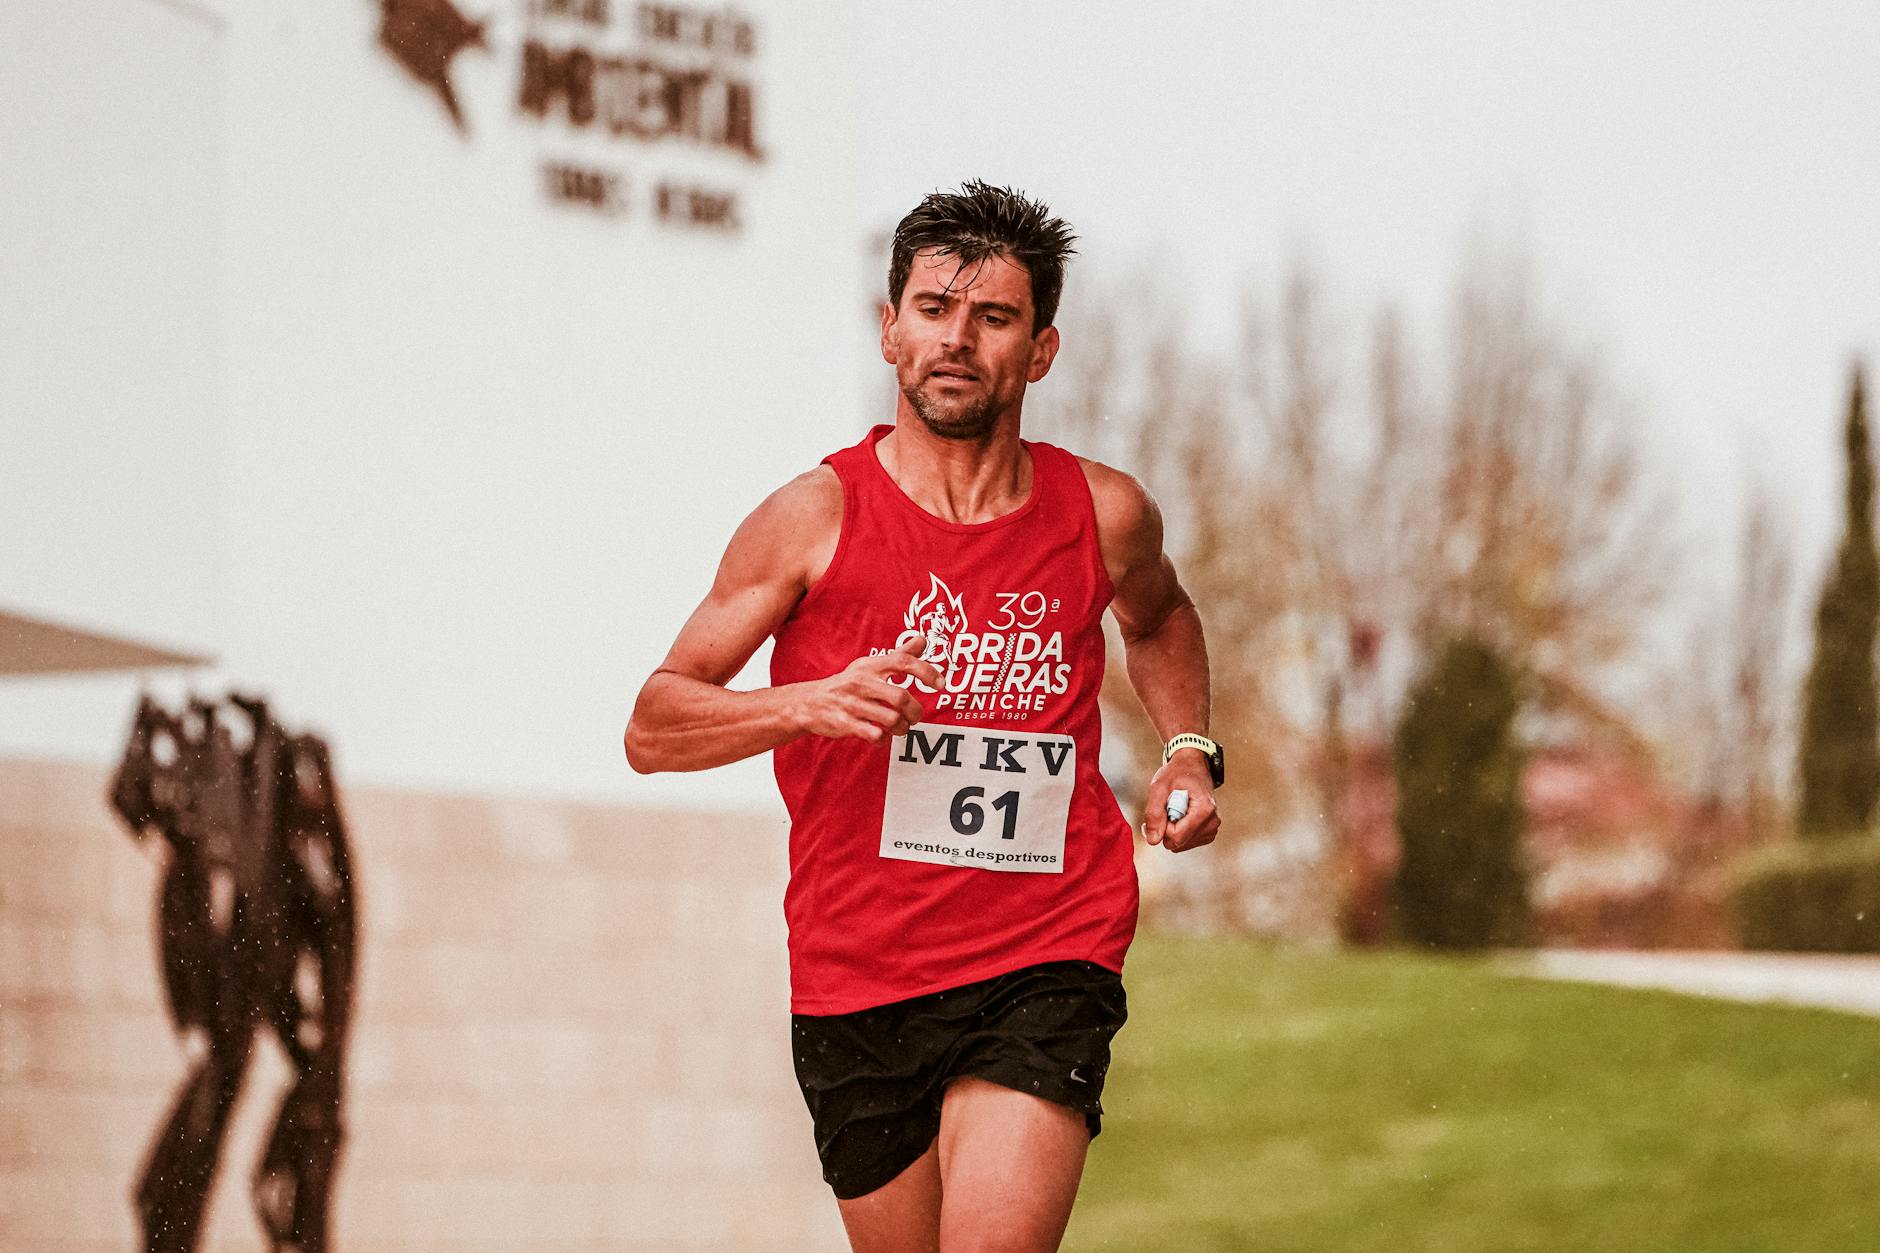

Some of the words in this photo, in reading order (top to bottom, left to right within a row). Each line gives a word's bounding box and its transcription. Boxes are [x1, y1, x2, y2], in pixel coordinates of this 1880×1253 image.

[936, 693, 1047, 711] PENICHE
[955, 712, 995, 721] DESDE
[1002, 712, 1028, 721] 1980
[949, 786, 1020, 840] 61
[894, 840, 960, 856] eventos
[965, 847, 1057, 864] desportivos
